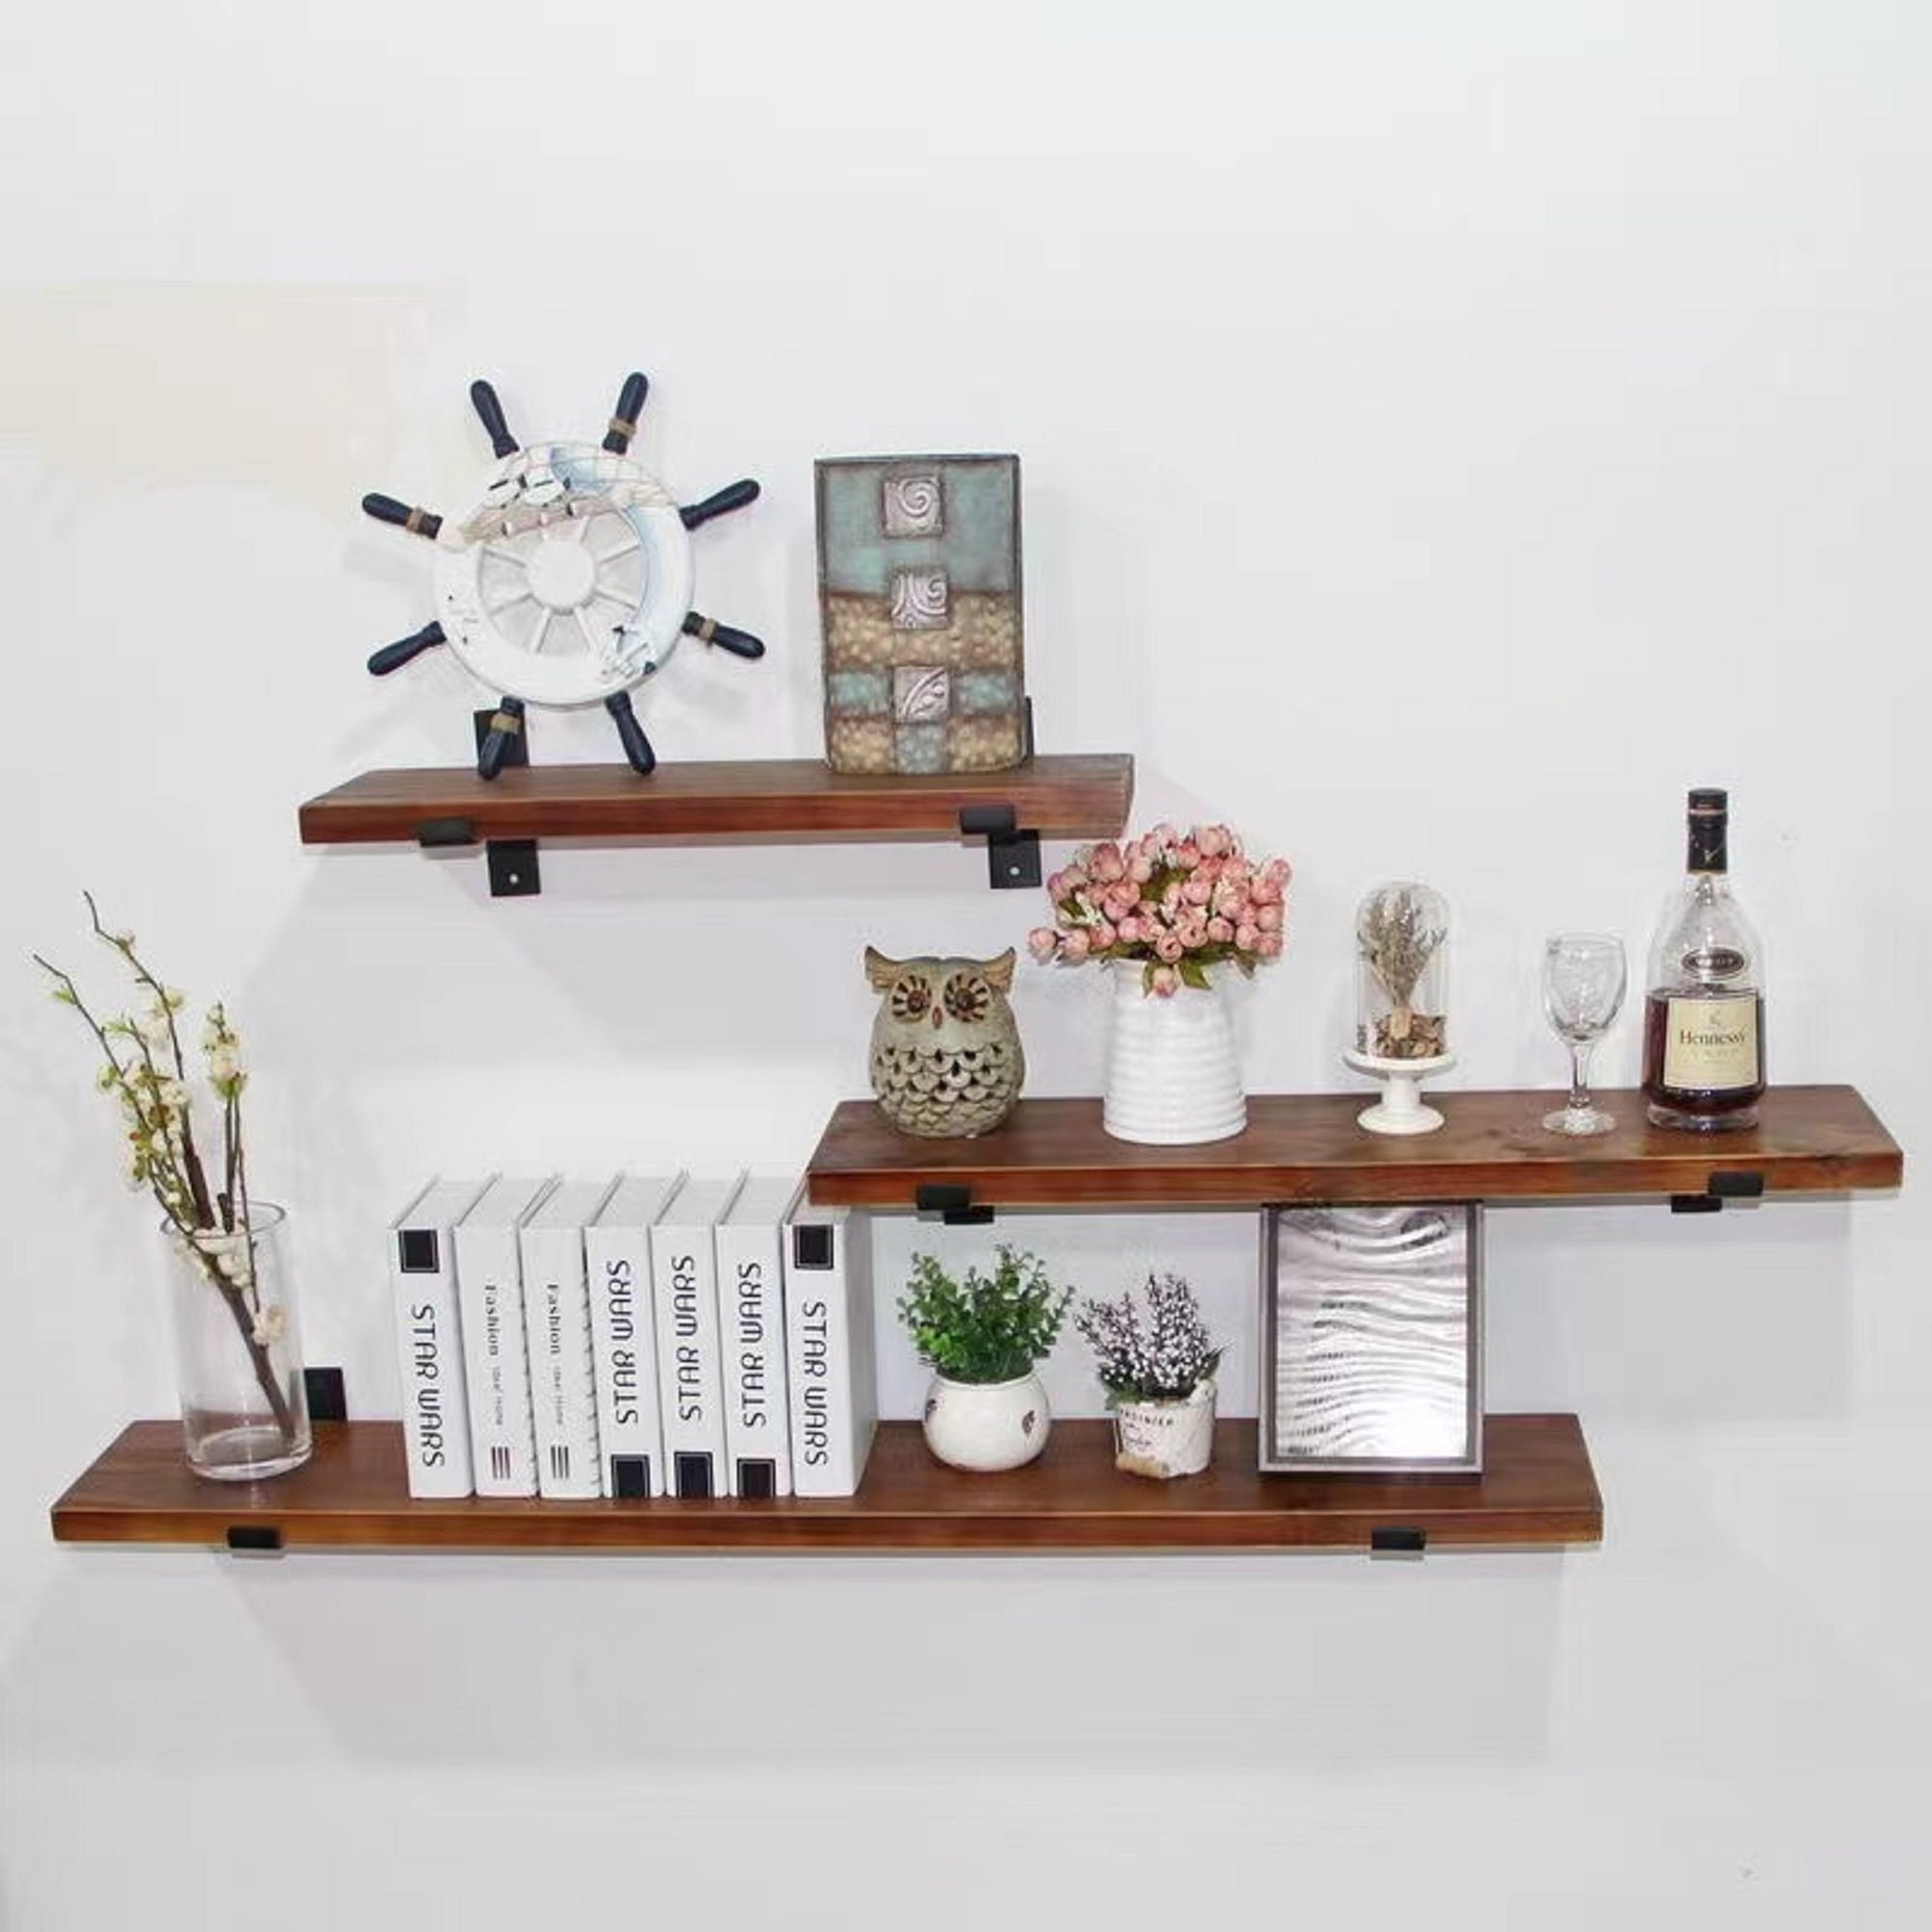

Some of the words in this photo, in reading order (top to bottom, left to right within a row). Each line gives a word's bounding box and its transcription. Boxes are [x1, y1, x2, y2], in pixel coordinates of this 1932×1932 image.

[1680, 1028, 1747, 1046] Hennessy
[484, 1284, 499, 1356] Fashion
[547, 1283, 562, 1355] Fashion
[607, 1260, 634, 1341] WARS
[672, 1255, 698, 1338] WARS
[738, 1263, 763, 1344] WARS
[413, 1304, 440, 1381] STAR
[803, 1301, 828, 1378] STAR
[611, 1350, 639, 1425] STAR
[677, 1347, 702, 1422] STAR
[743, 1352, 767, 1429] STAR
[417, 1388, 445, 1468] WARS
[803, 1386, 829, 1466] WARS
